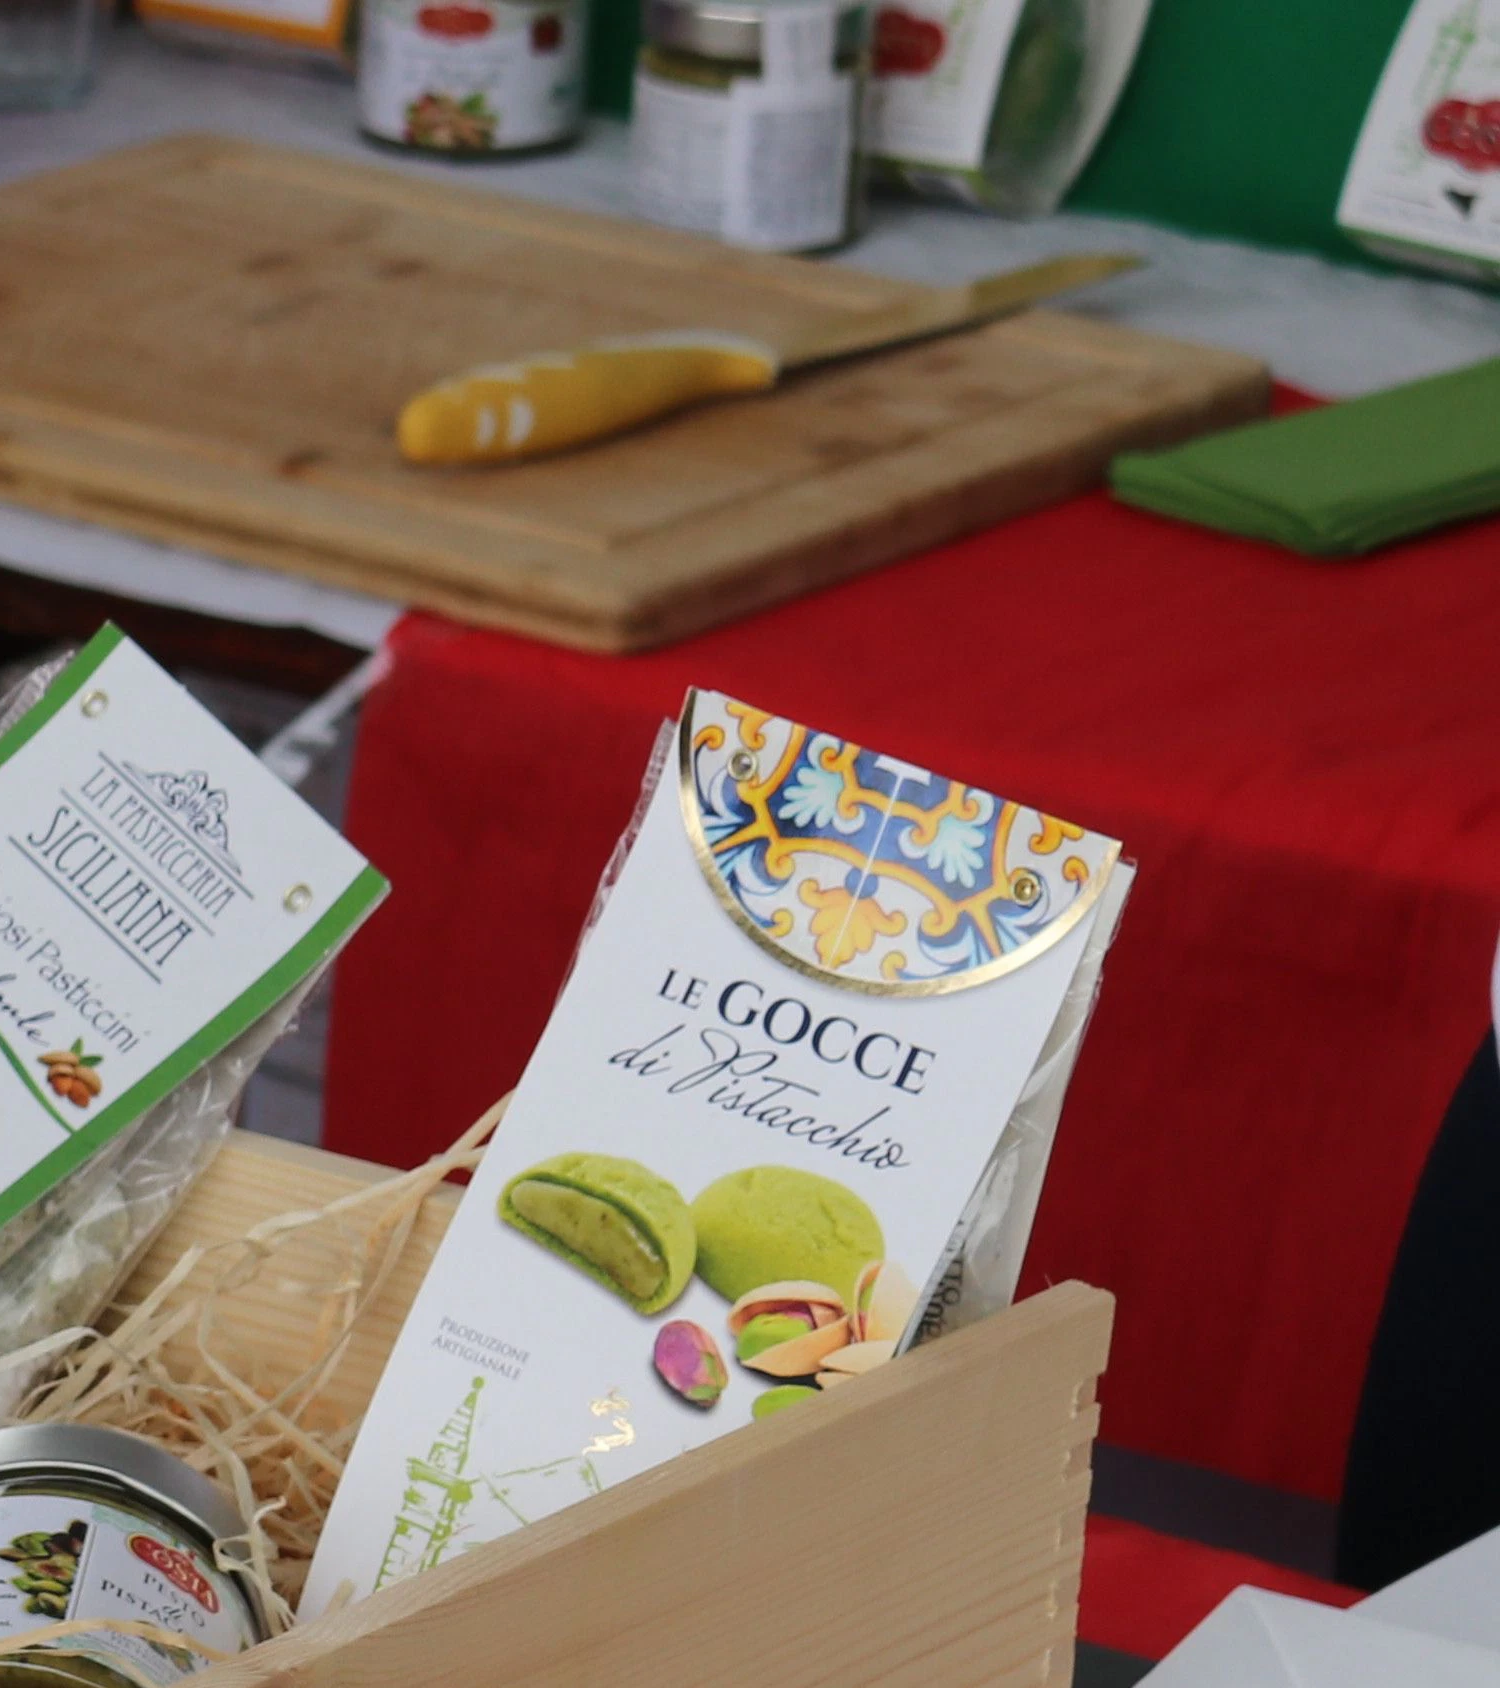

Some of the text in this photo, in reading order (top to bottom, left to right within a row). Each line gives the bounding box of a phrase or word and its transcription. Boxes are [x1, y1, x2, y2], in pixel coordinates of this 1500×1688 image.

[23, 804, 195, 970] SICILIANA
[78, 765, 239, 920] LA PASTICCERIA
[25, 934, 151, 1058] Pasticcini
[655, 968, 938, 1096] LE GOCCE
[608, 1023, 910, 1173] di Pistacchio
[438, 1315, 531, 1367] PRODUZIONE
